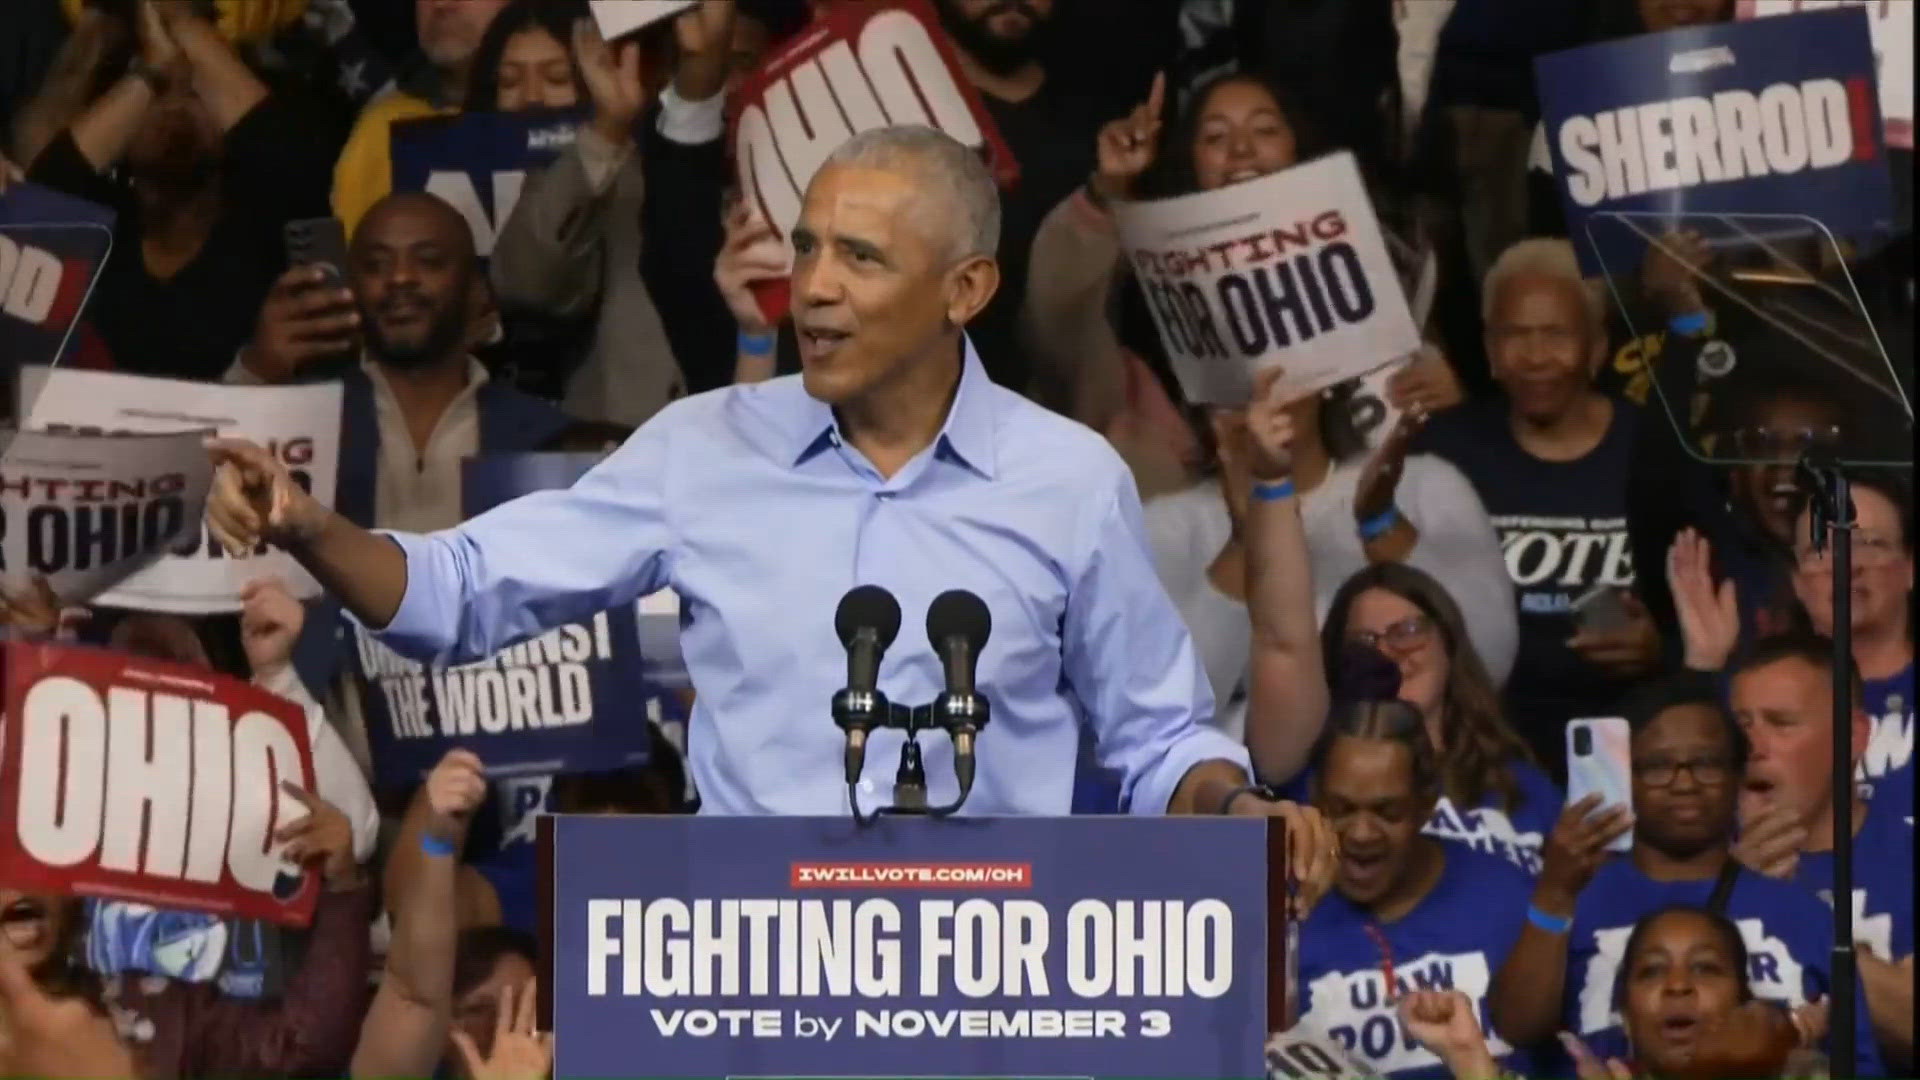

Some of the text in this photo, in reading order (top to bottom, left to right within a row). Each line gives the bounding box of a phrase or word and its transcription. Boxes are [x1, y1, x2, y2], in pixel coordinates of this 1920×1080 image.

[1217, 242, 1375, 357] OHIO
[380, 663, 593, 739] THE WORLD
[17, 676, 307, 893] OHIO
[797, 866, 1023, 883] IWILLVOTE.COM/OH
[587, 898, 1234, 999] FIGHTING FOR OHIO
[650, 1009, 1172, 1041] VOTE by NOVEMBER 3
